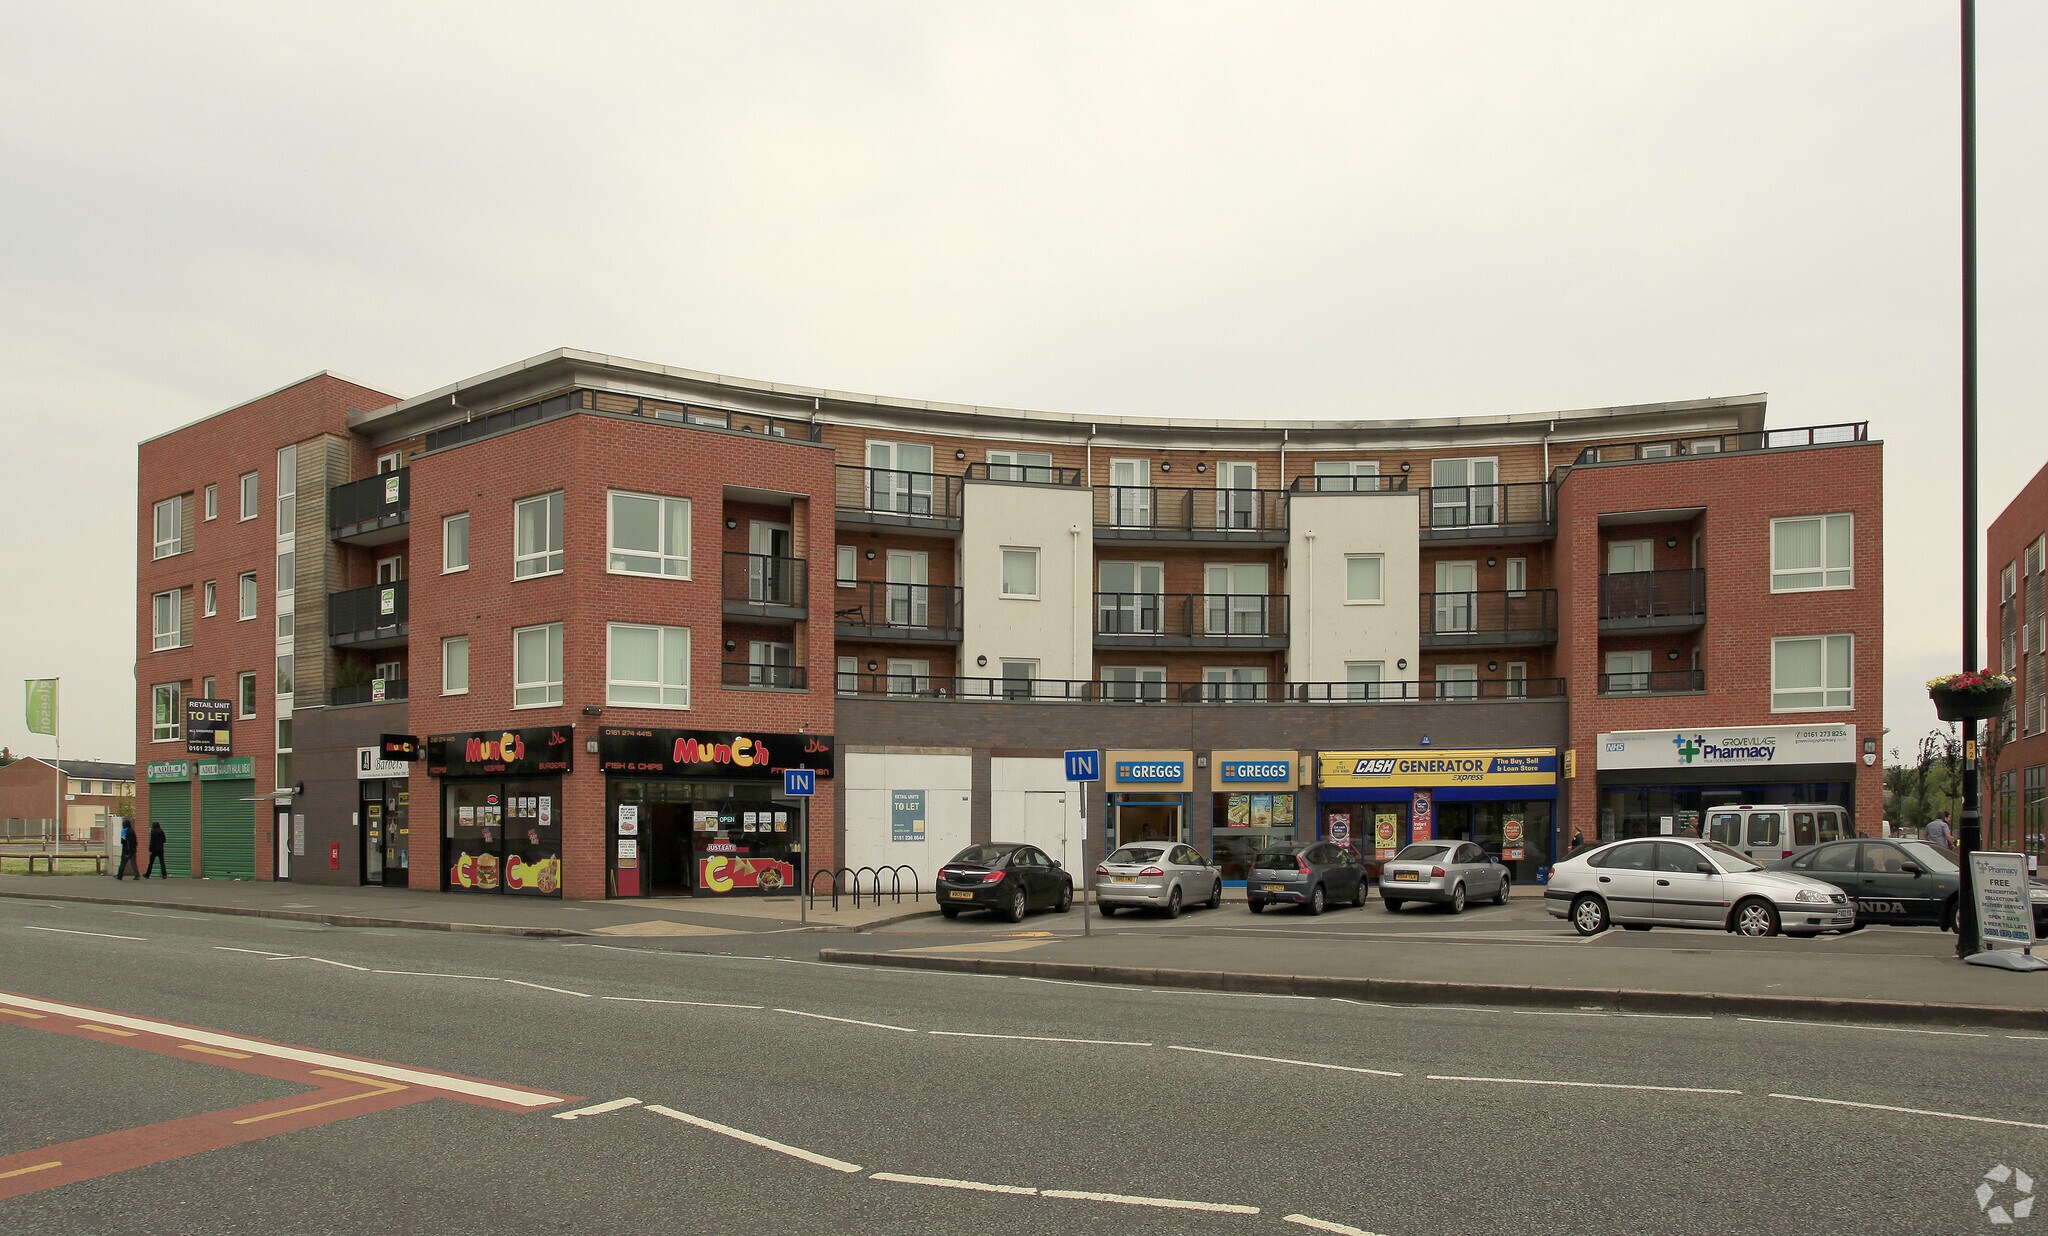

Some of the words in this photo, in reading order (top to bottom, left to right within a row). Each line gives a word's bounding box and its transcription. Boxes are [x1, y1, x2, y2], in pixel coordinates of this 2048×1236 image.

[188, 711, 205, 721] TO
[208, 711, 230, 721] LET
[1606, 743, 1624, 751] NHS
[1703, 745, 1776, 761] Pharmacy
[605, 761, 626, 769] FISH
[627, 762, 636, 770] &
[637, 763, 663, 771] CHIPS
[1071, 756, 1092, 775] IN
[1132, 765, 1181, 778] GREGGS
[1237, 765, 1286, 778] GREGGS
[1355, 760, 1396, 773] CASH
[1399, 759, 1484, 773] GENERATOR
[791, 774, 808, 790] IN
[894, 802, 905, 811] TO
[905, 802, 920, 811] LET
[1988, 866, 2018, 876] Pharmacy
[1989, 879, 2010, 887] FREE
